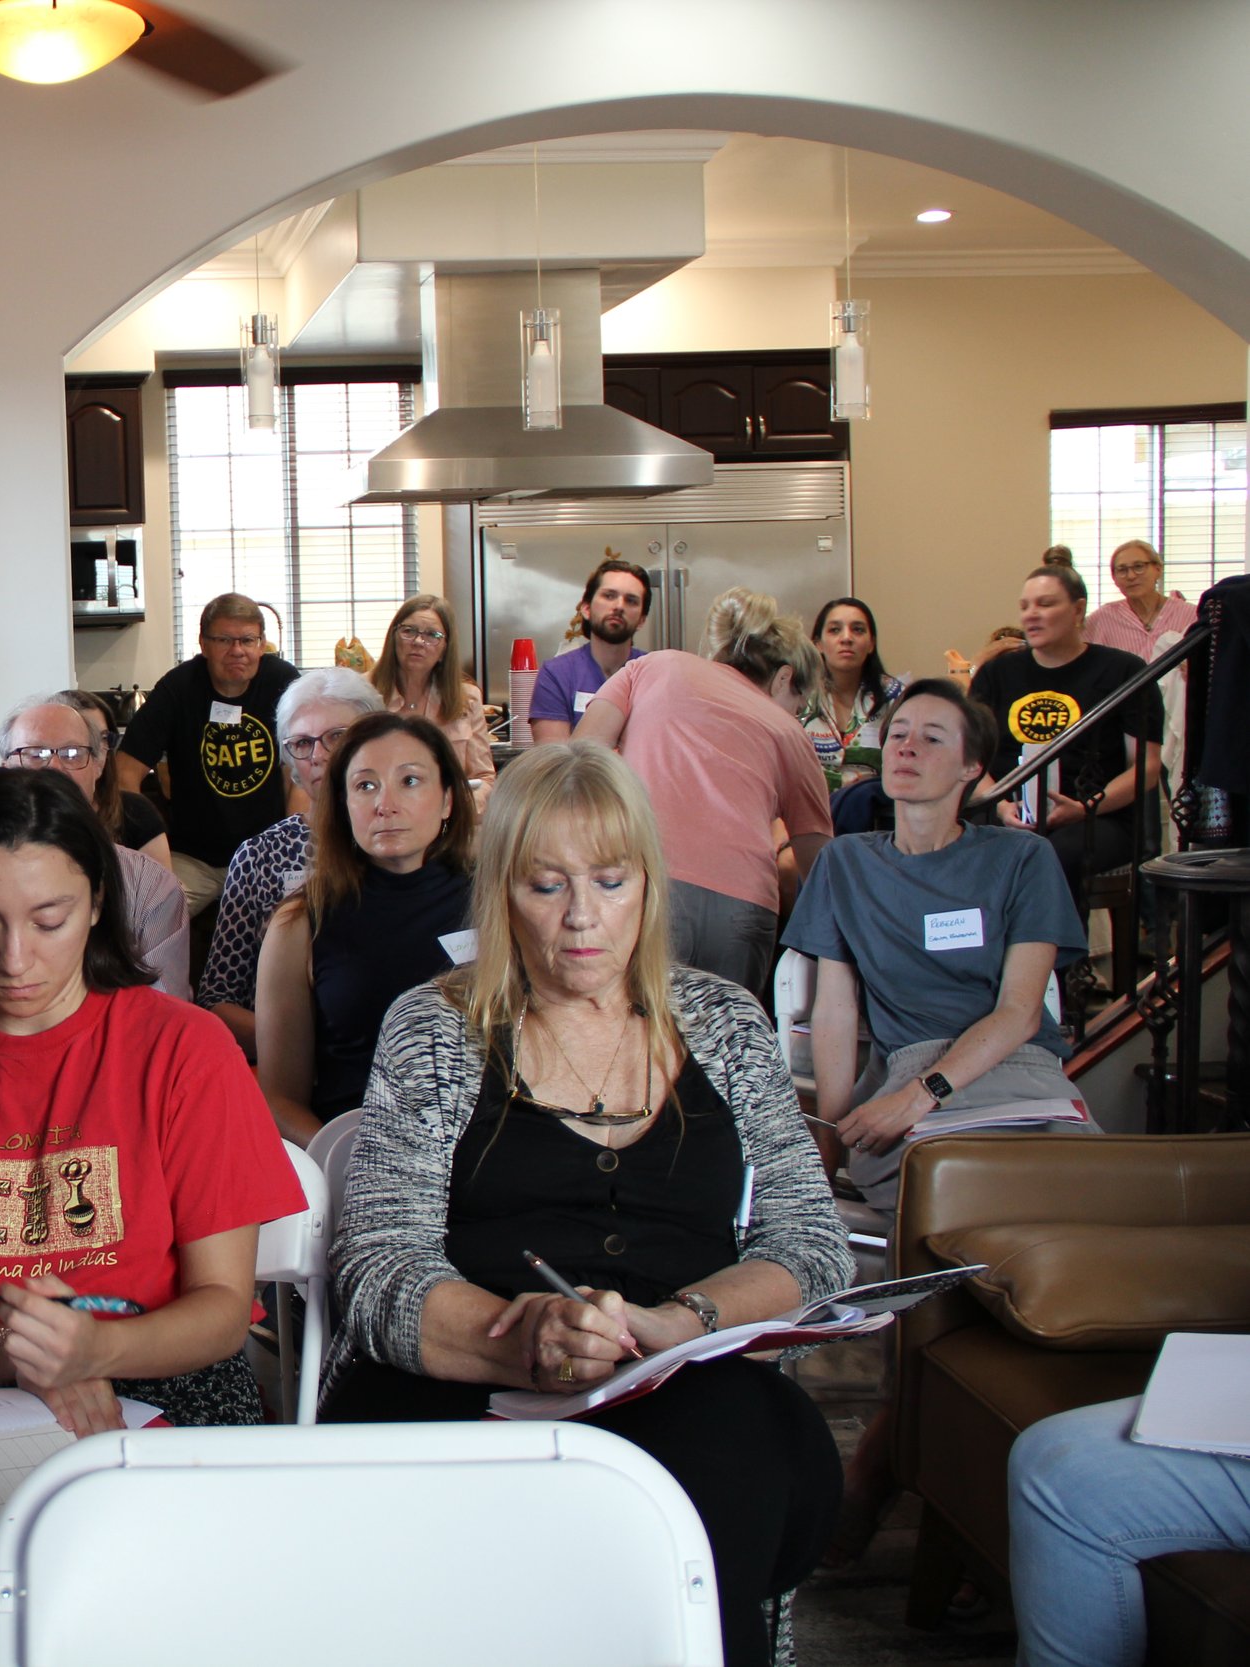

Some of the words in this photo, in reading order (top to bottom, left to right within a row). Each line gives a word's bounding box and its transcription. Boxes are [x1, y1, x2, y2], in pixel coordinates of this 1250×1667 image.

[1019, 710, 1069, 727] SAFE
[205, 738, 268, 768] SAFE
[30, 1258, 53, 1279] de
